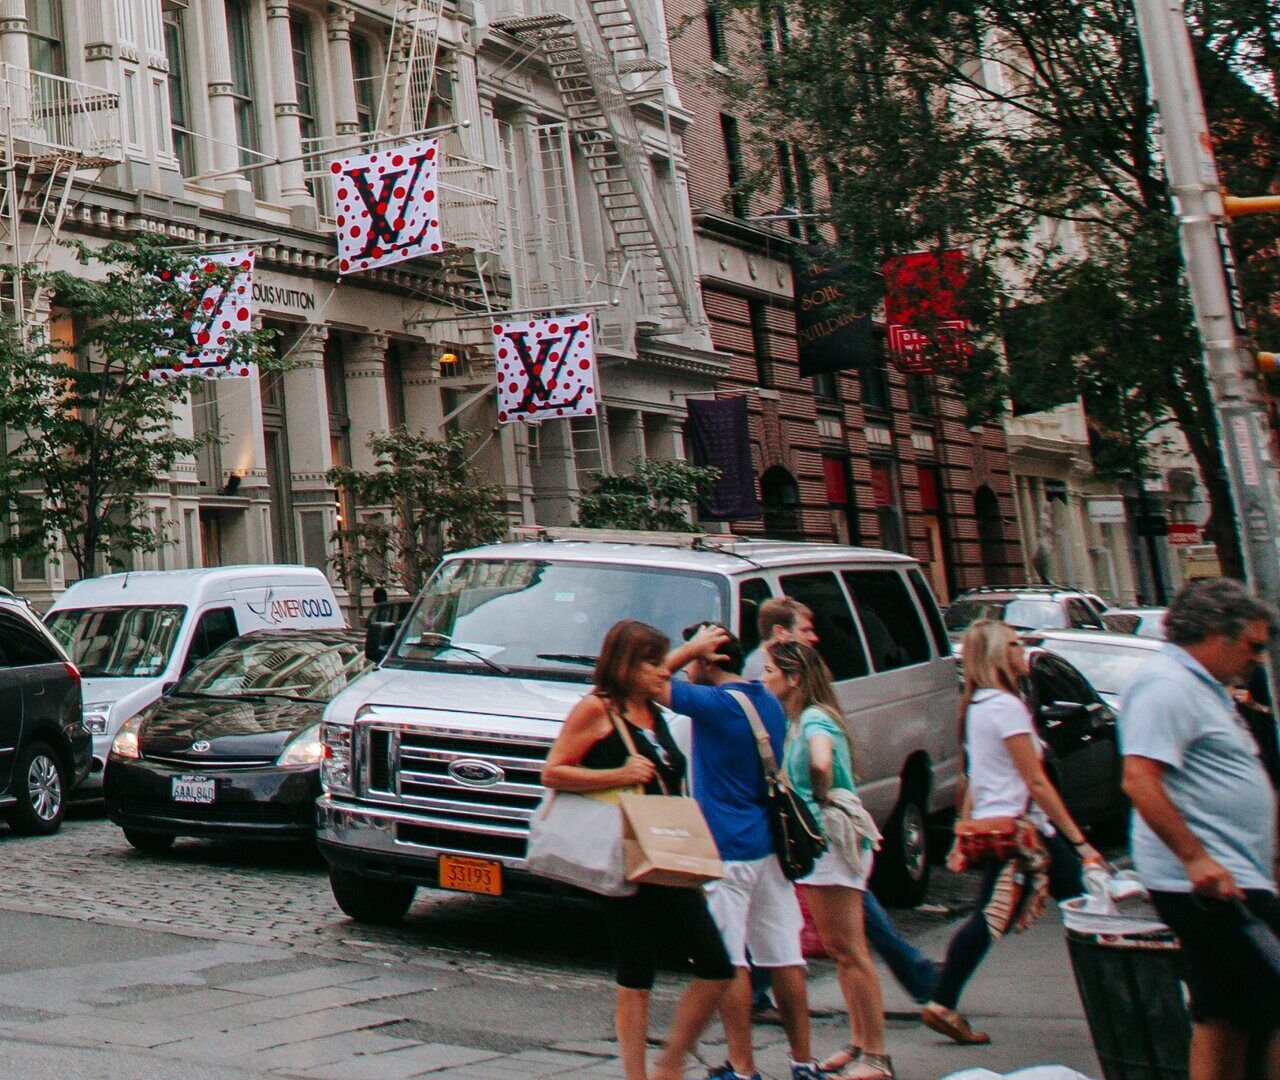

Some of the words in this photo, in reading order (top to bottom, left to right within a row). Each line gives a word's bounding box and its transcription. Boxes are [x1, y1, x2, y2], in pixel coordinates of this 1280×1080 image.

[251, 282, 275, 304] OUIS
[276, 288, 315, 310] VUITTON
[271, 599, 332, 618] AMERICOLD
[448, 865, 492, 886] 33193
